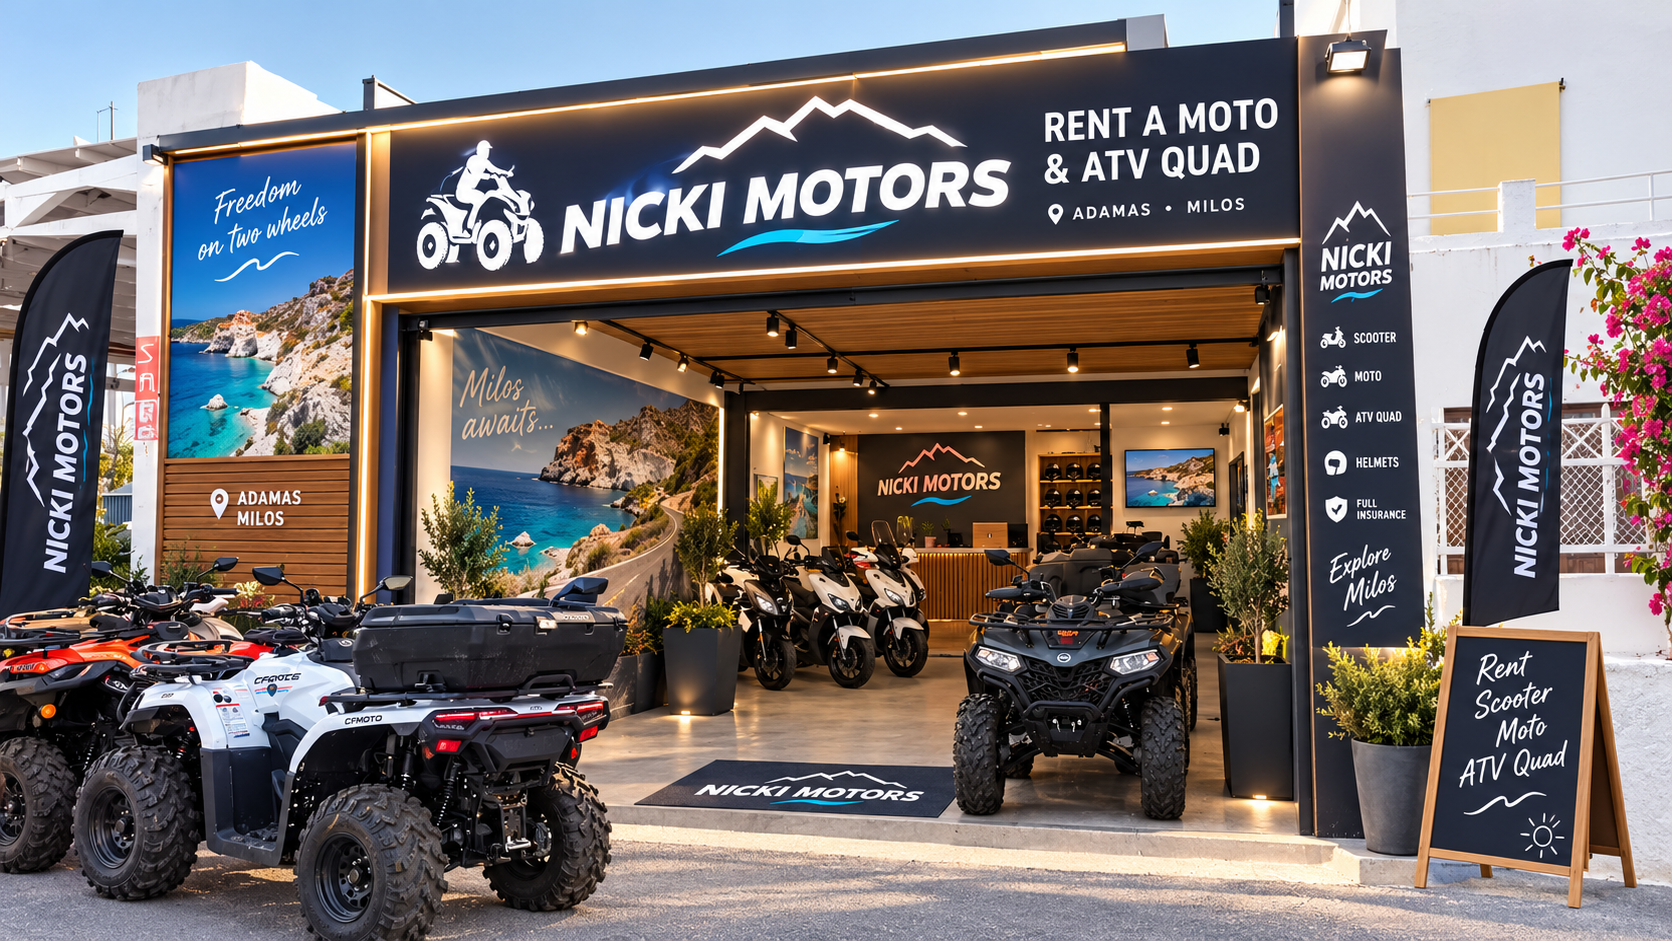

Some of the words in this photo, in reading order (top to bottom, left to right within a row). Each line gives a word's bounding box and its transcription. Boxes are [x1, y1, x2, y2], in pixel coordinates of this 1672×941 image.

[1045, 107, 1132, 143] RENT
[1142, 105, 1167, 136] A
[1178, 98, 1279, 135] MOTO
[1044, 153, 1070, 185] &
[1081, 148, 1150, 183] ATV
[1161, 142, 1260, 180] QUAD
[214, 175, 302, 225] Freedom
[560, 181, 727, 255] NICKI
[743, 159, 1012, 225] MOTORS
[1072, 203, 1151, 221] ADAMAS
[1187, 197, 1245, 214] MILOS
[198, 240, 225, 261] on
[227, 223, 262, 254] two
[266, 196, 328, 239] wheels
[1320, 241, 1392, 273] NICKI
[1319, 269, 1393, 292] MOTORS
[1353, 331, 1397, 344] SCOOTER
[459, 365, 525, 408] Milos
[1354, 370, 1382, 382] MOTO
[52, 352, 88, 483] MOTORS
[1355, 412, 1374, 423] ATV
[1376, 411, 1402, 422] QUAD
[1517, 372, 1545, 492] MOTORS
[1356, 457, 1400, 468] HELMETS
[237, 490, 302, 505] ADAMAS
[877, 476, 919, 496] NICKI
[922, 472, 1002, 492] MOTORS
[237, 510, 284, 526] MILOS
[1356, 499, 1378, 508] FULL
[1356, 509, 1407, 520] INSURANCE
[43, 491, 75, 574] NICKI
[1513, 498, 1539, 579] NICKI
[1329, 544, 1392, 584] Explore
[1343, 570, 1398, 612] Milos
[1476, 650, 1533, 686] Rent
[1474, 681, 1554, 720] Scooter
[344, 715, 383, 725] CFMOTO
[1495, 713, 1548, 748] Moto
[1459, 752, 1507, 788] ATV
[1513, 739, 1568, 777] Quad
[694, 784, 791, 797] NICKI
[792, 786, 925, 802] MOTORS
